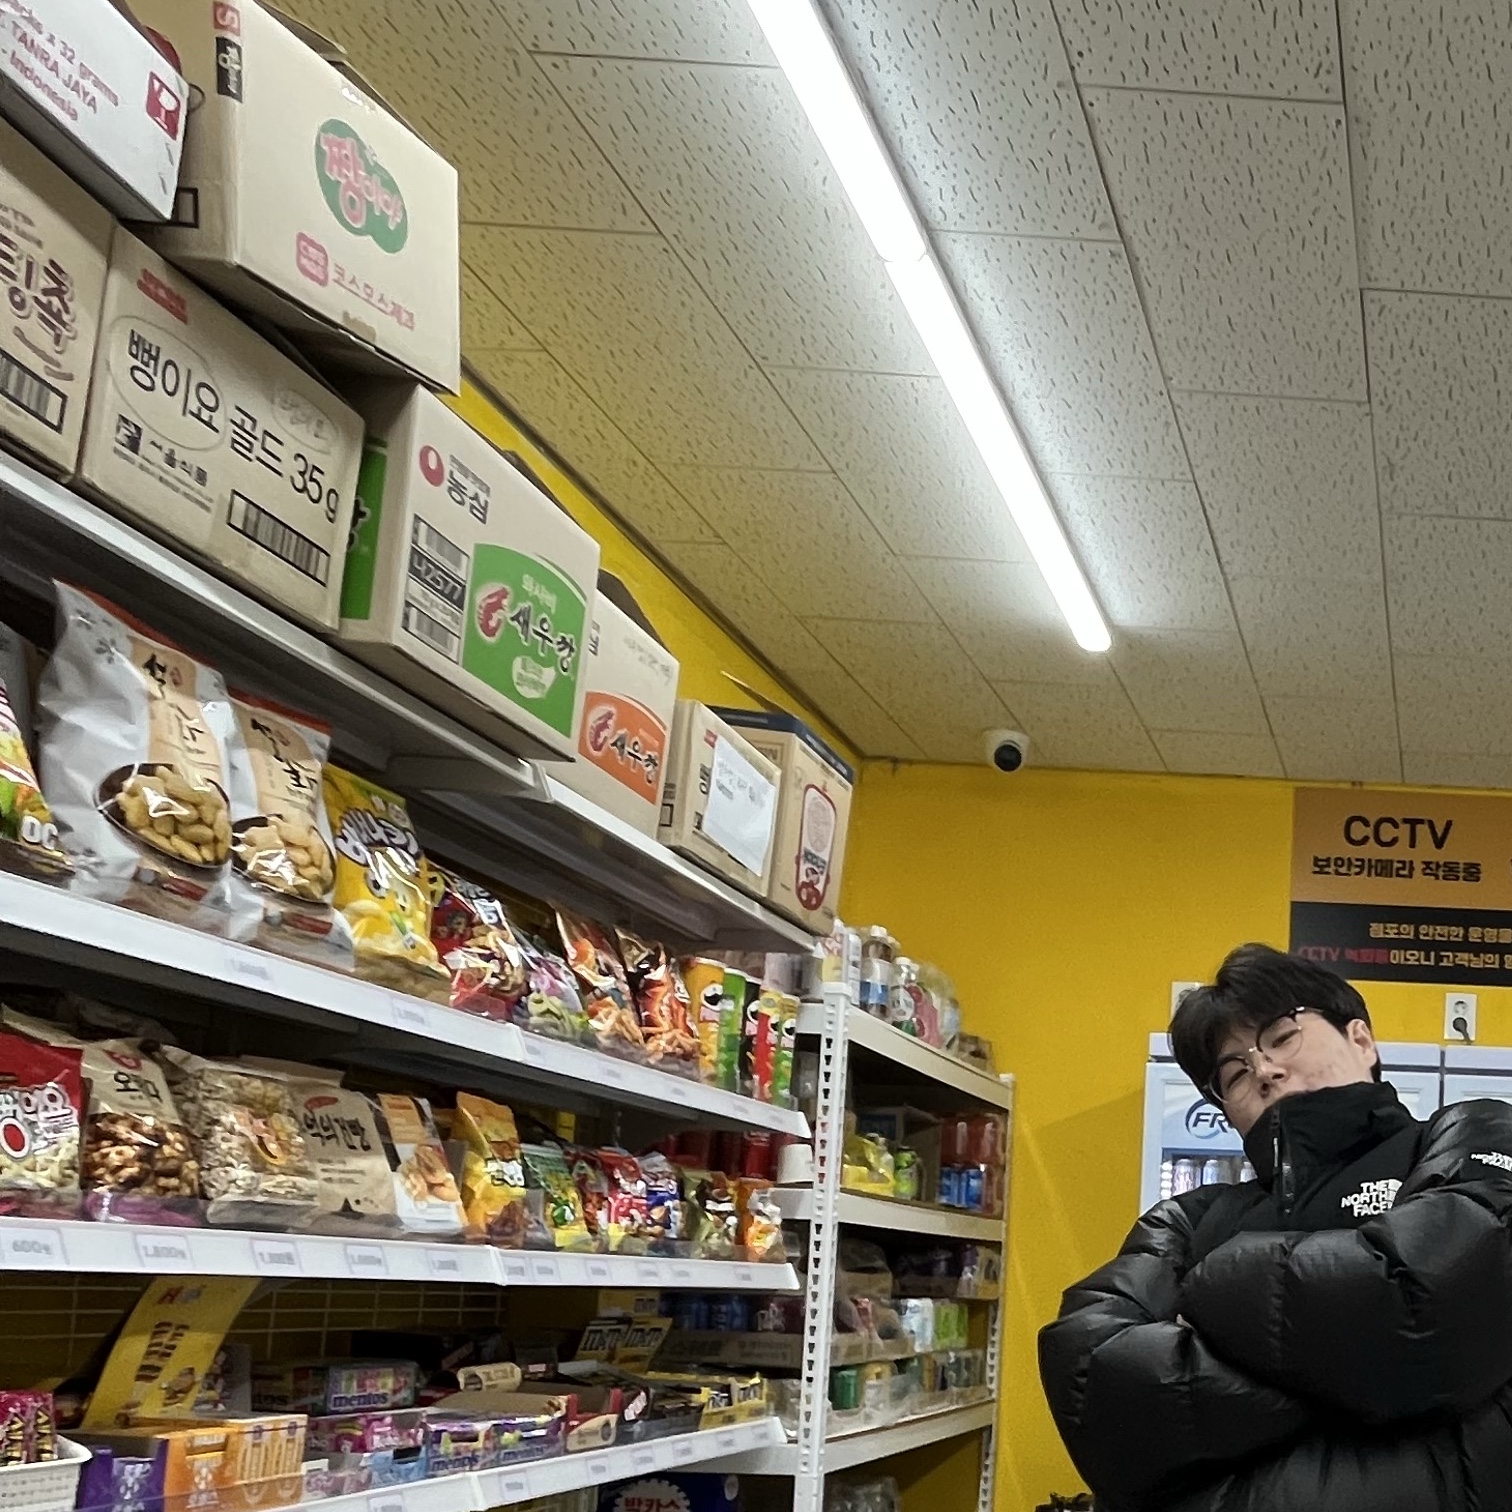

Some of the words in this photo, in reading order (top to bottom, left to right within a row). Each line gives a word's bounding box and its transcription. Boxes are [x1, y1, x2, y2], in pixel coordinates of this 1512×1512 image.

[129, 329, 220, 433] 뻥이요
[230, 405, 285, 478] 골드
[290, 454, 340, 522] 35g
[1343, 815, 1454, 850] CCTV
[1312, 856, 1416, 880] 보안카메라
[1421, 860, 1483, 883] 작동중
[1368, 922, 1414, 940] 점포의
[1418, 924, 1464, 942] 안전한
[1439, 952, 1500, 969] 고객님의
[1360, 1180, 1389, 1195] THE
[1341, 1190, 1388, 1208] NORTH
[1353, 1202, 1388, 1217] FACE
[330, 1392, 389, 1412] mentos
